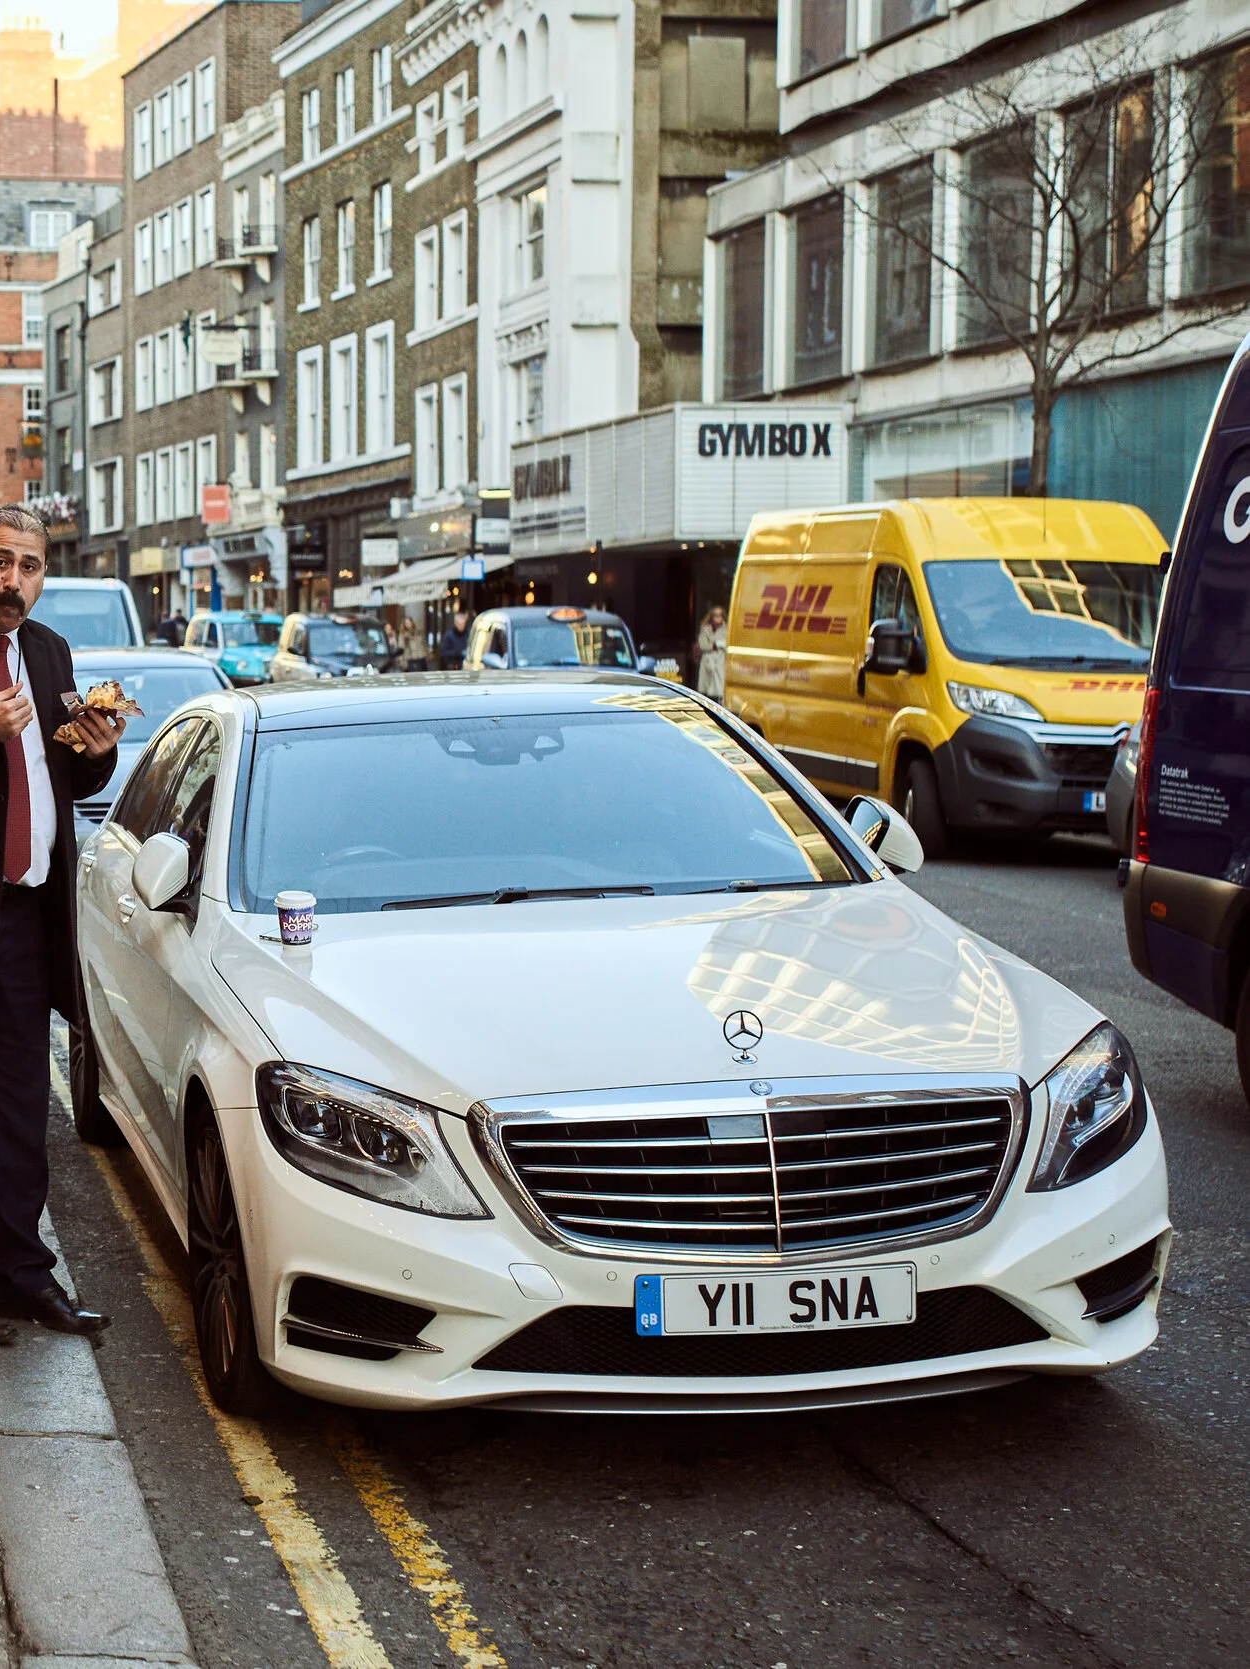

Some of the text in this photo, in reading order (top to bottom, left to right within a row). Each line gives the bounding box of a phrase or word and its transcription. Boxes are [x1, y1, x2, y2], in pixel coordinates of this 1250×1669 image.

[756, 584, 833, 633] DHL
[1160, 763, 1189, 780] Datatrak
[788, 1275, 880, 1324] SNA
[640, 1313, 659, 1326] GB
